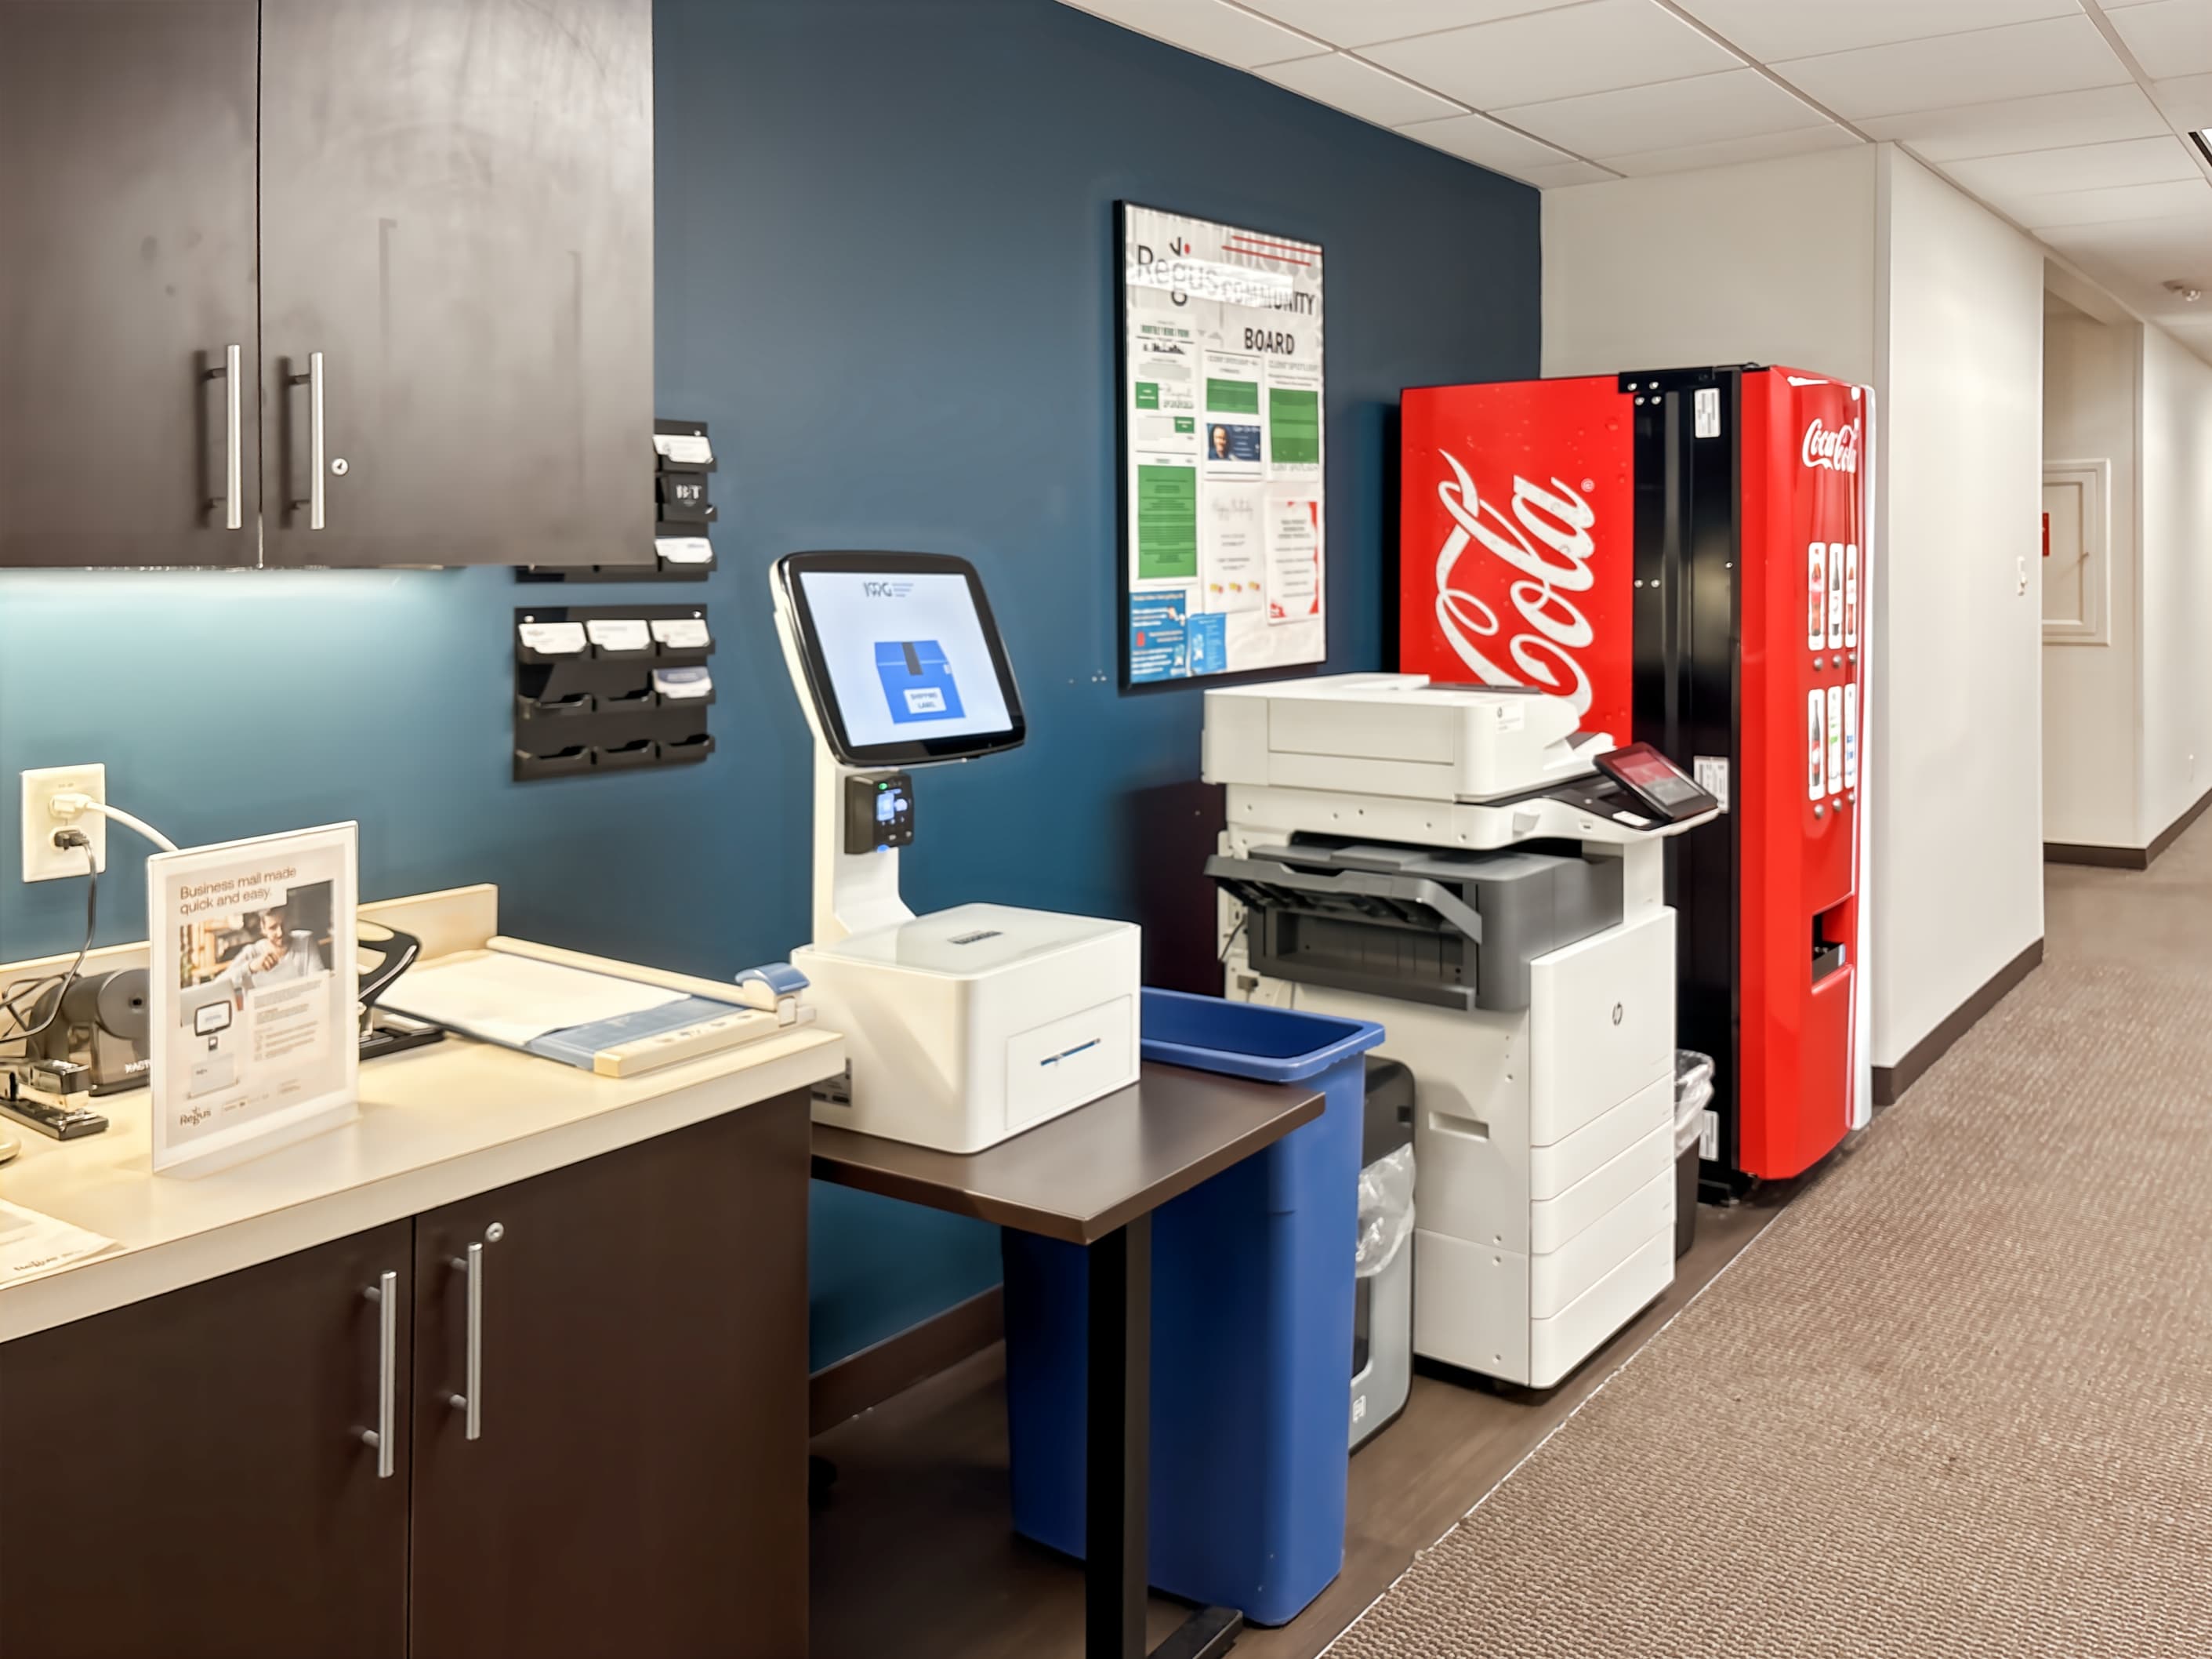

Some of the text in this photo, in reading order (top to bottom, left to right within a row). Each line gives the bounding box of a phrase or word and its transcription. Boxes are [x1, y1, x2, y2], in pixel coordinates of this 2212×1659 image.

[1244, 327, 1295, 354] BOARD
[1436, 448, 1595, 717] Cola
[179, 866, 297, 900] Business mail made
[179, 896, 214, 916] quick
[216, 892, 240, 907] and
